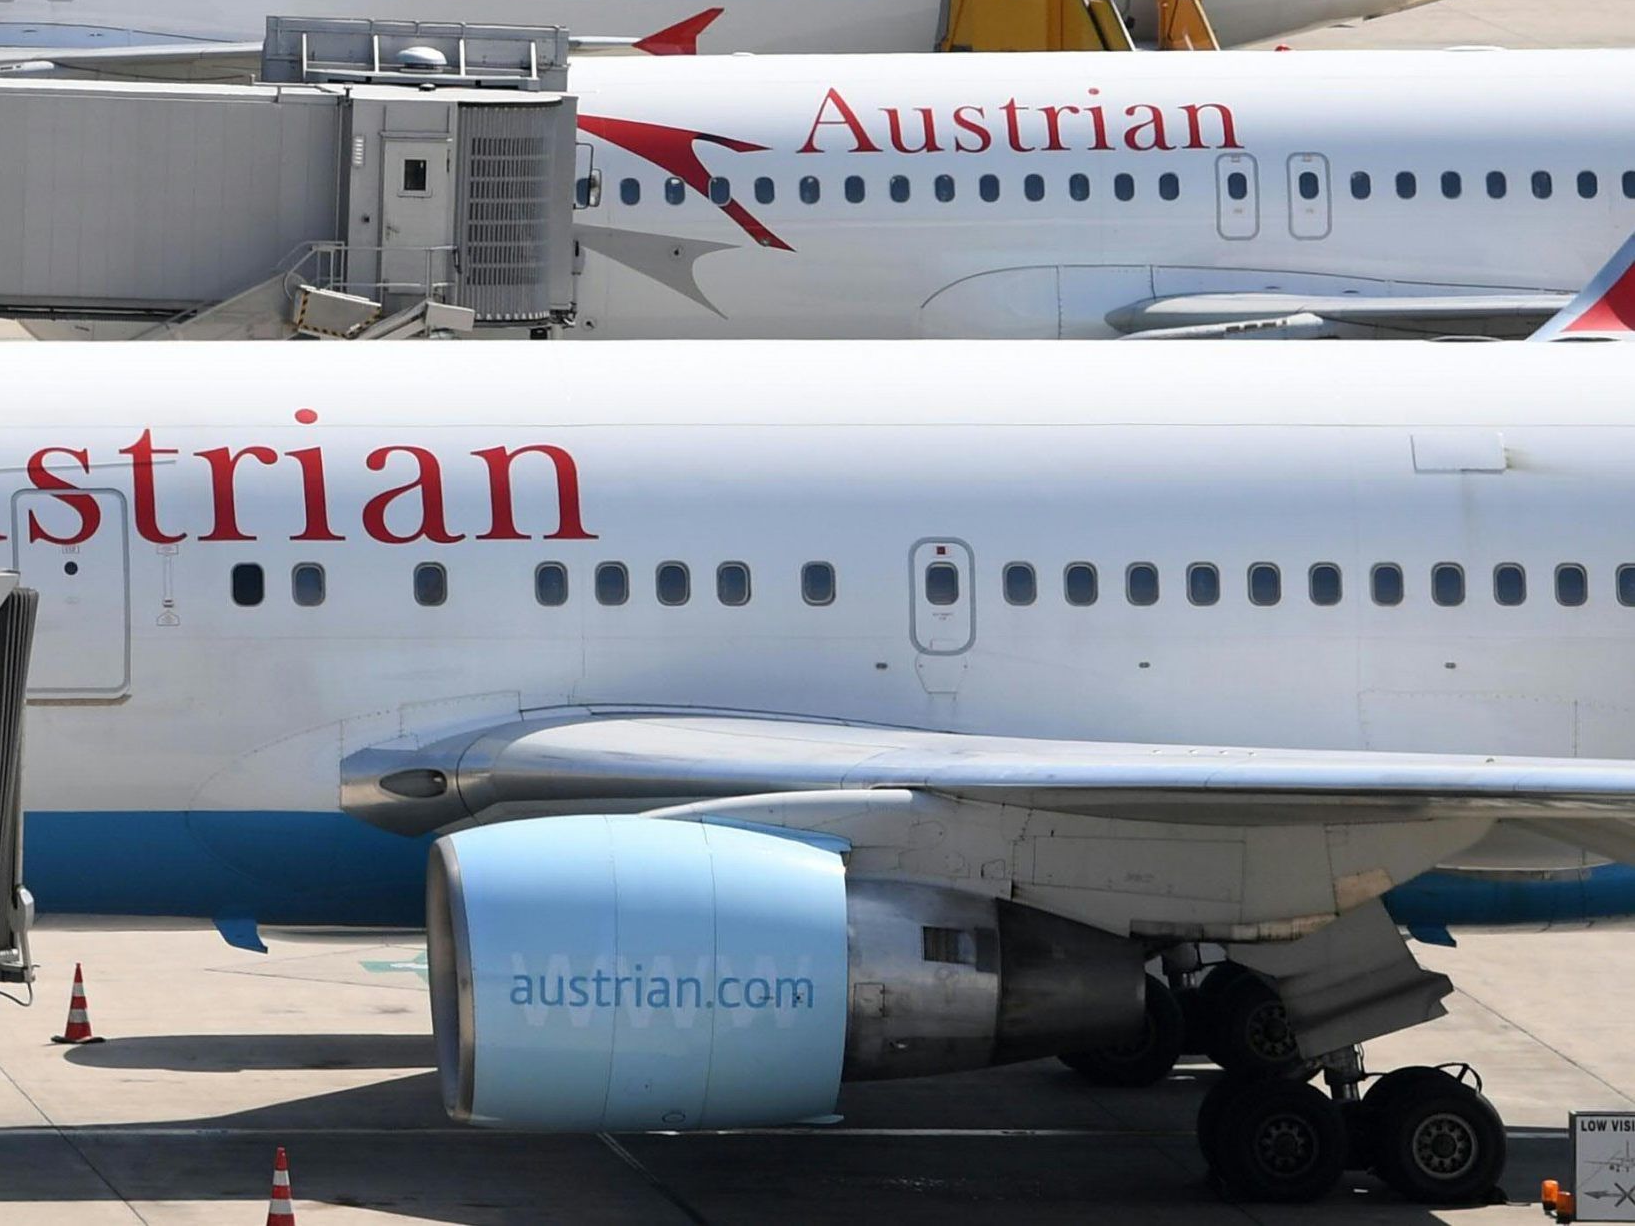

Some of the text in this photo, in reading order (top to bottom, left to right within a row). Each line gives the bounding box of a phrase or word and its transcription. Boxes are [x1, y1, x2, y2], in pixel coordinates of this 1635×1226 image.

[796, 87, 1245, 153] Austrian
[509, 964, 814, 1009] austrian.com
[1580, 1119, 1608, 1132] LOW
